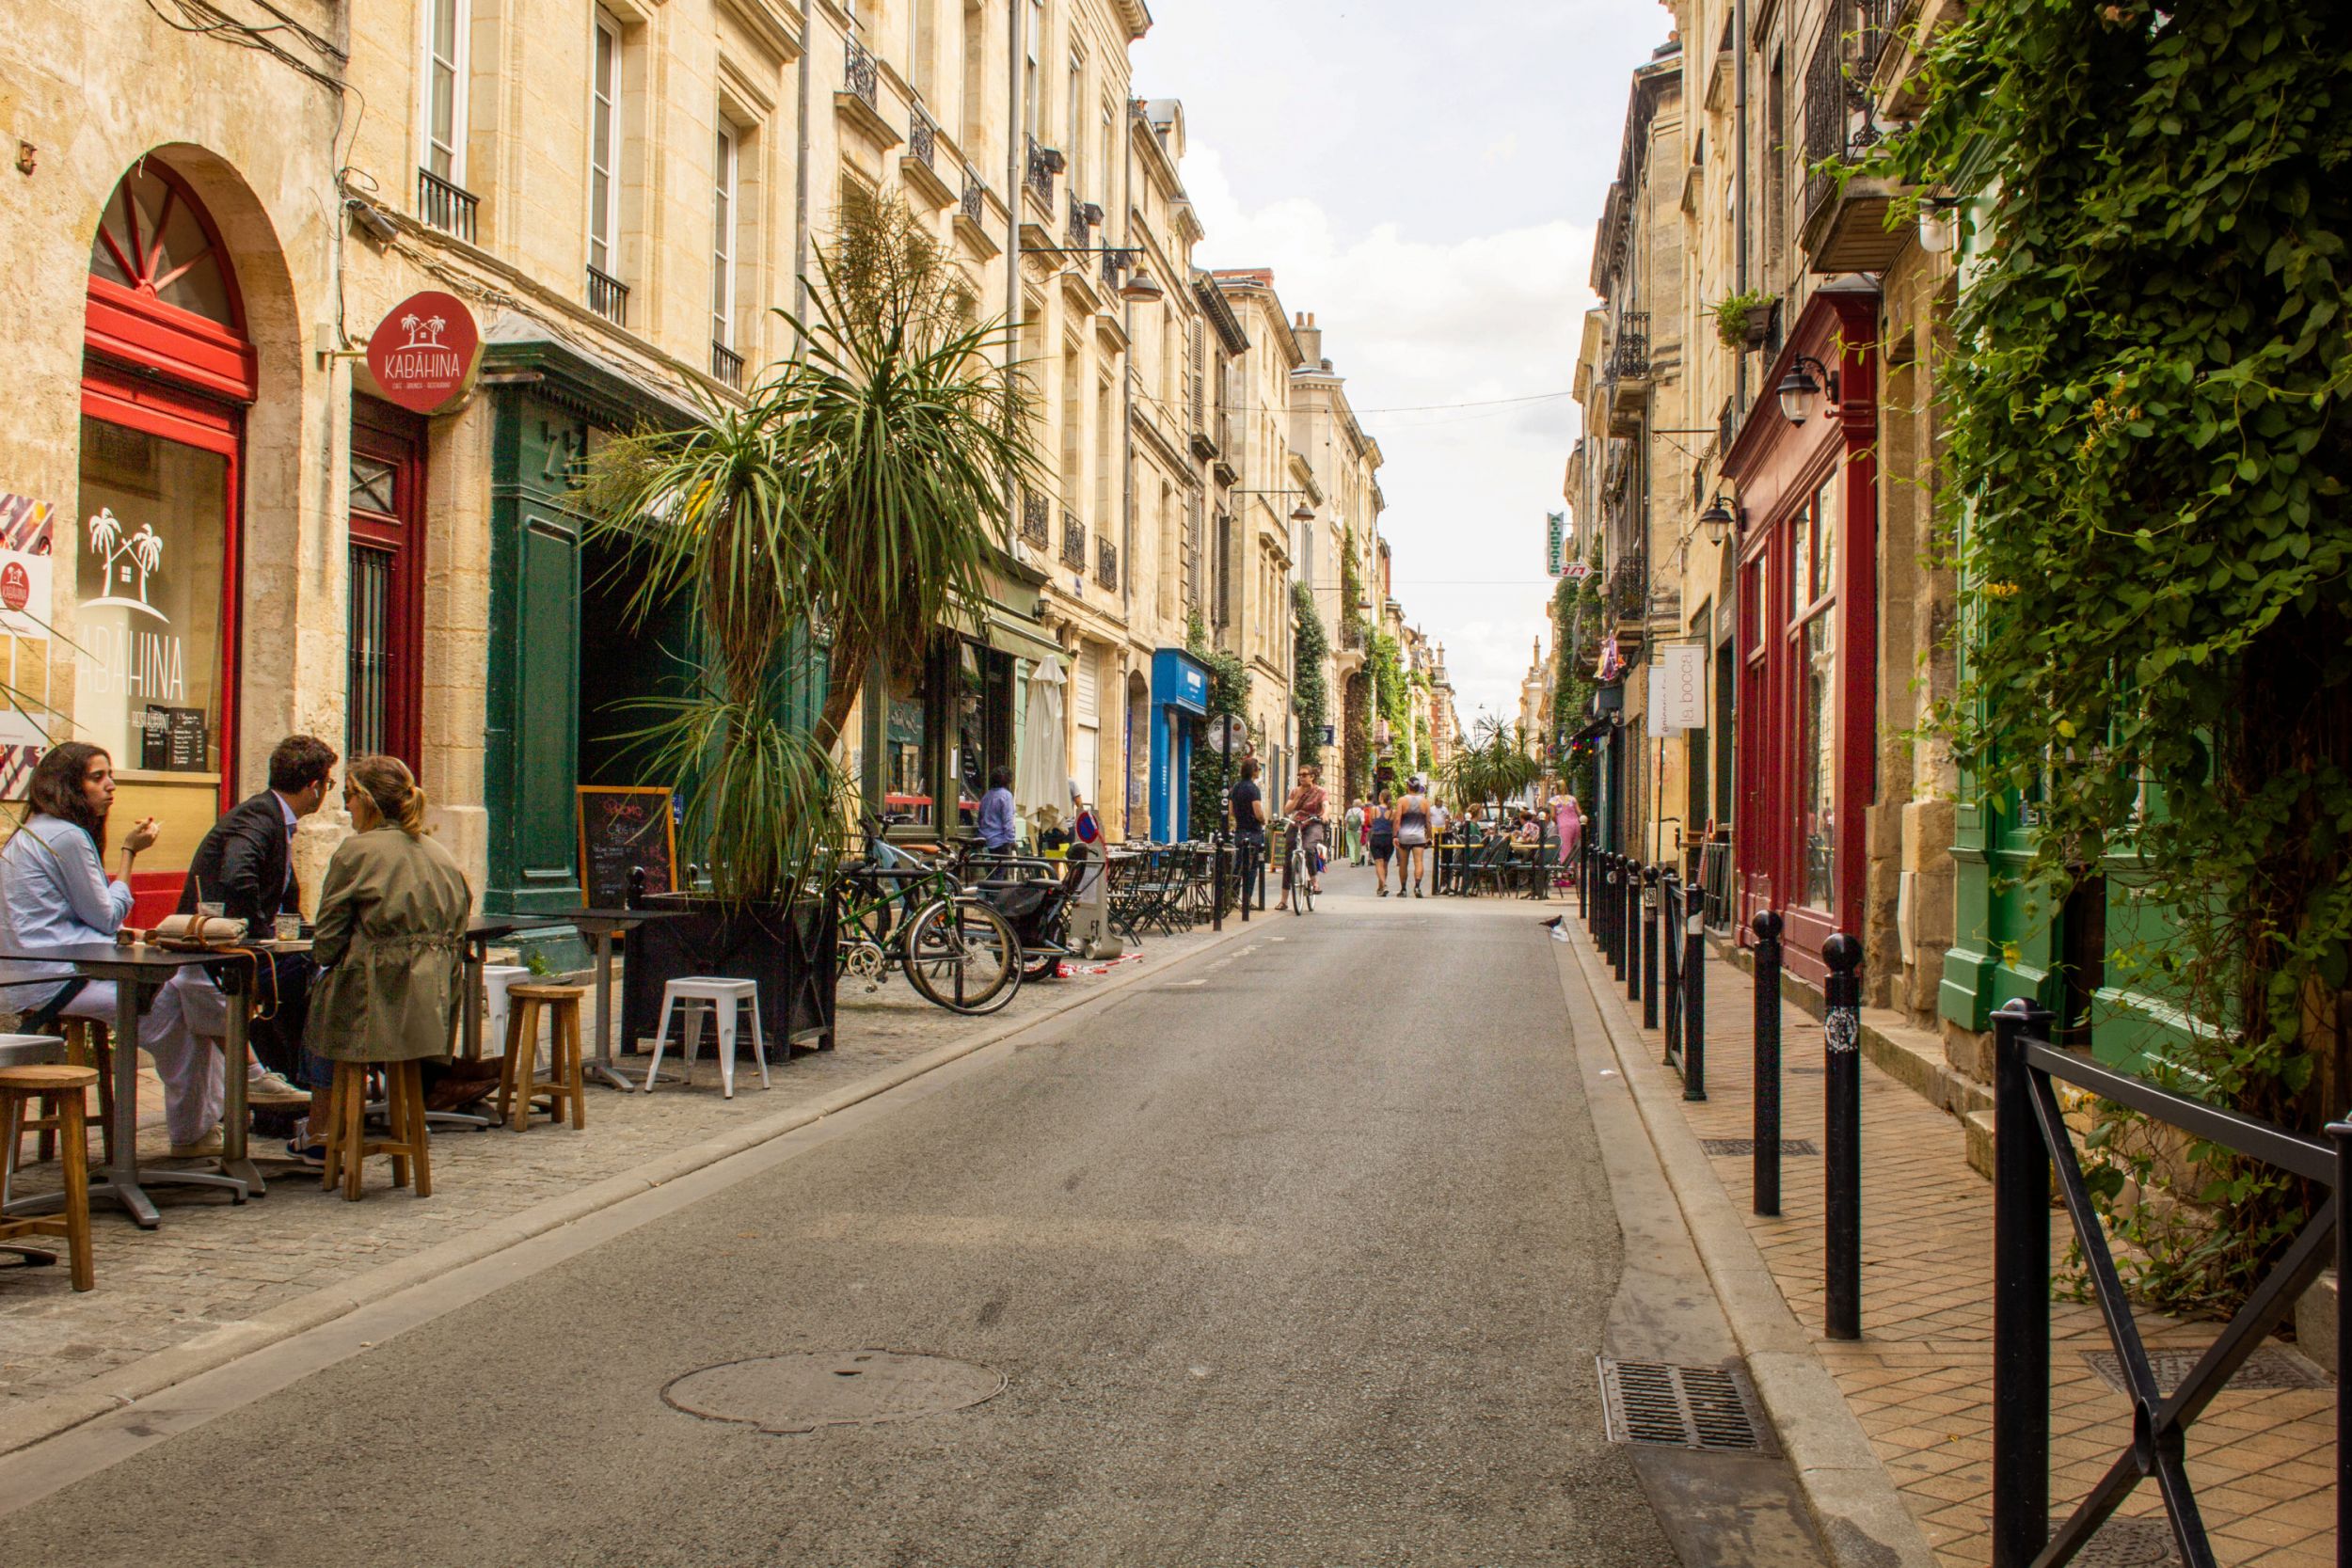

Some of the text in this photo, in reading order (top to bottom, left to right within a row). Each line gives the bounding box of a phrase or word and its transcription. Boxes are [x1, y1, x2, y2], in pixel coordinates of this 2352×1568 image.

[1550, 516, 1561, 574] ALIMENTATION
[1562, 566, 1585, 576] 7/7
[1679, 708, 1693, 722] la
